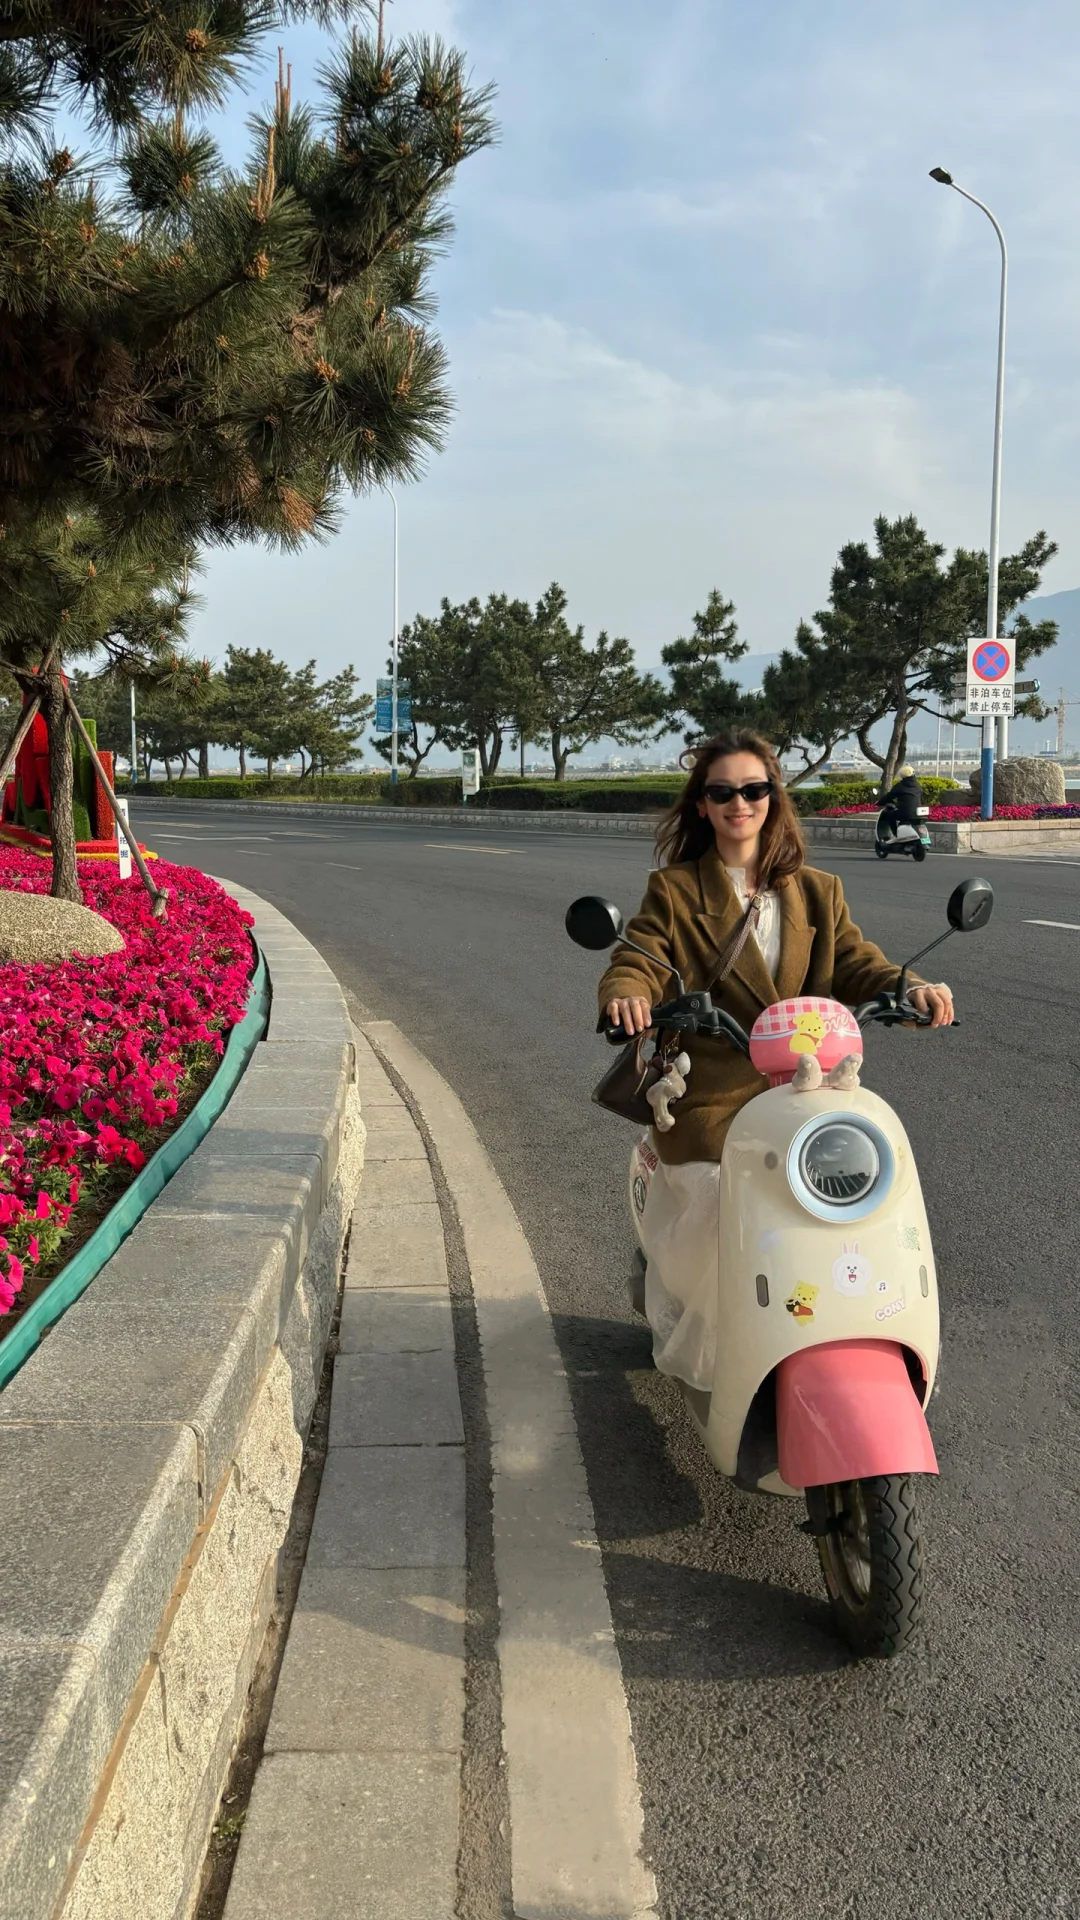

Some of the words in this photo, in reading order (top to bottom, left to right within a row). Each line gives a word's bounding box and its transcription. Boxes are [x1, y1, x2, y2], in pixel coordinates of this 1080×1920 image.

[969, 687, 1011, 698] 非泊车位
[969, 701, 1011, 712] 禁止停车
[875, 1297, 905, 1321] CONY
